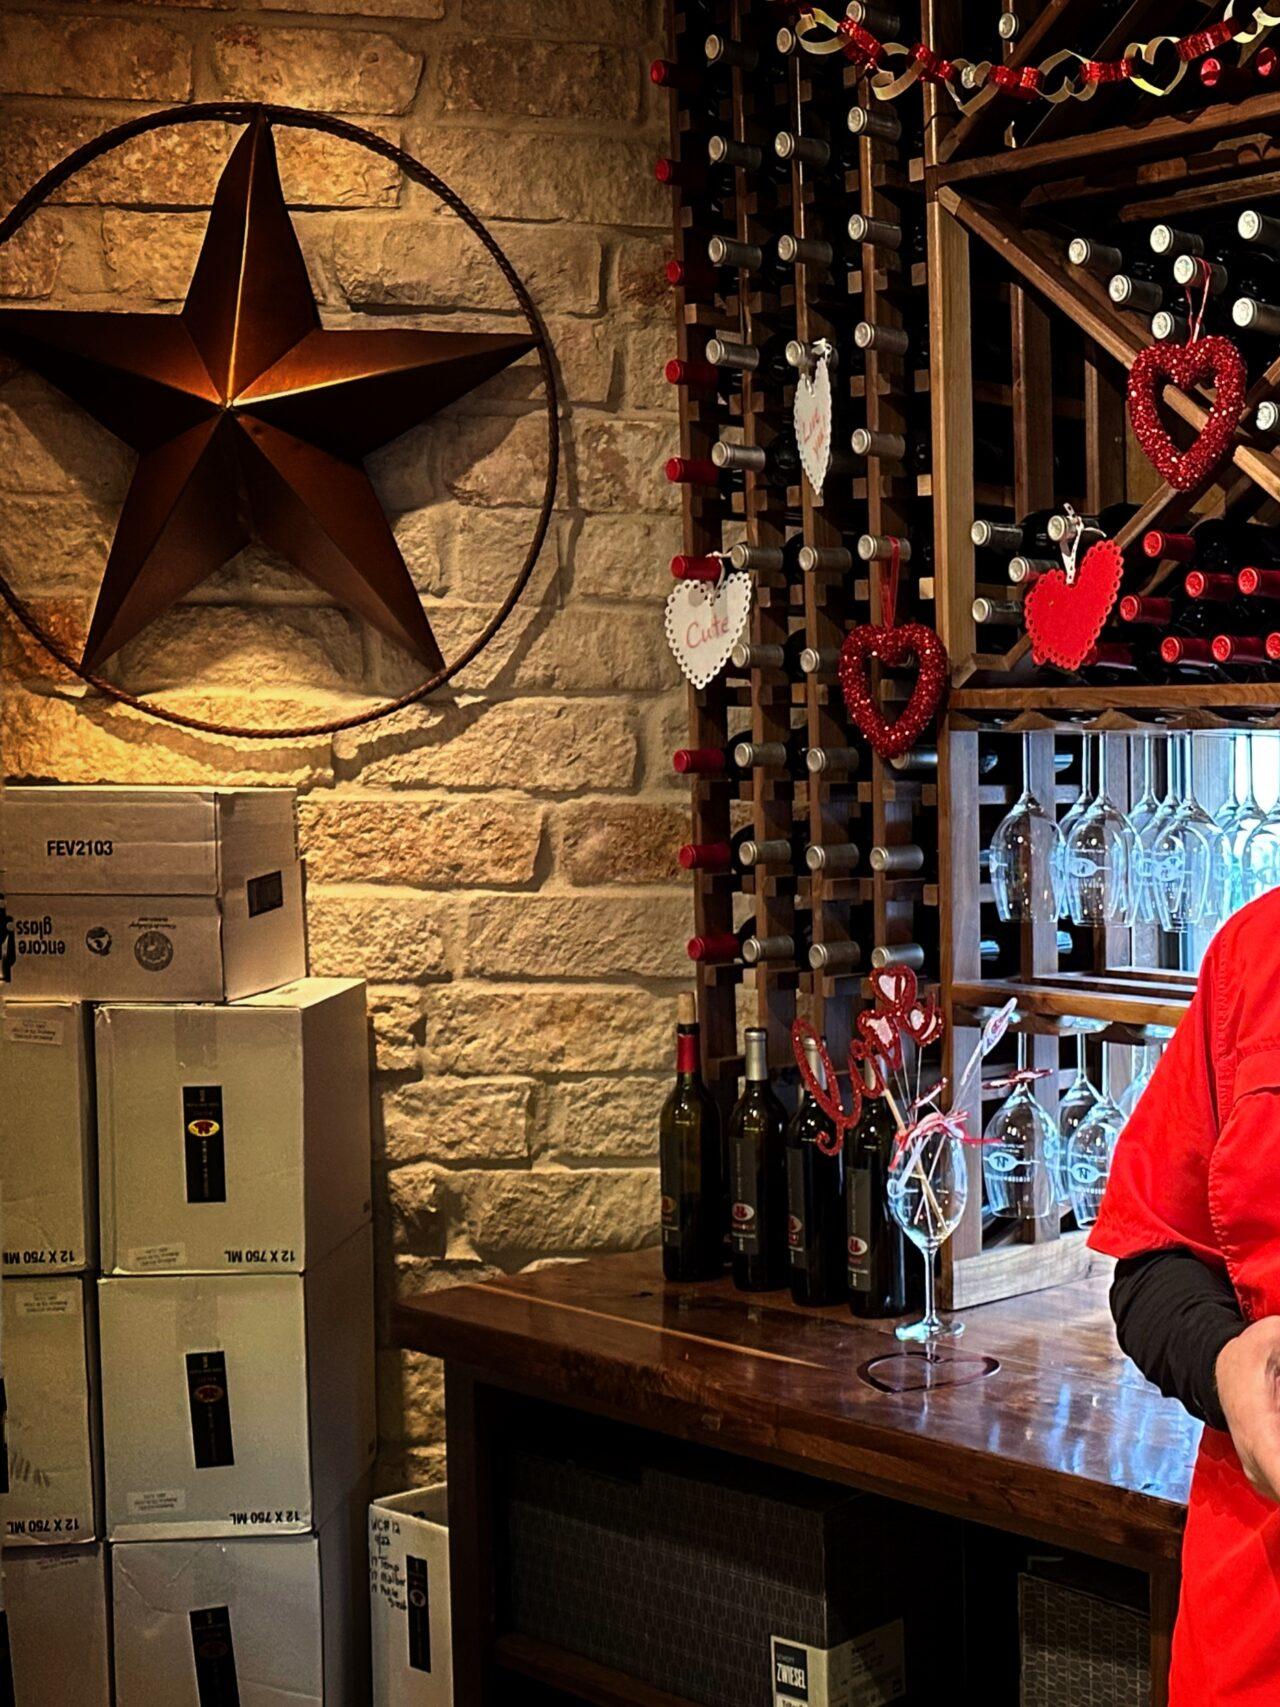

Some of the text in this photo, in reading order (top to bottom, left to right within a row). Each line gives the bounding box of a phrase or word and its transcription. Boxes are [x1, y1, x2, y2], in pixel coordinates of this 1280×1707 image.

[685, 613, 730, 648] Cute
[46, 840, 113, 857] FEV2103
[16, 916, 52, 938] glass
[18, 939, 66, 955] encore
[23, 1251, 45, 1264] 750
[48, 1250, 57, 1263] X
[60, 1250, 75, 1263] 12
[224, 1250, 296, 1263] 12 X 750 ML
[229, 1510, 300, 1525] 12 X 750 ML
[6, 1518, 79, 1534] 12 X 750 ML
[776, 1662, 806, 1690] ZWIESEL
